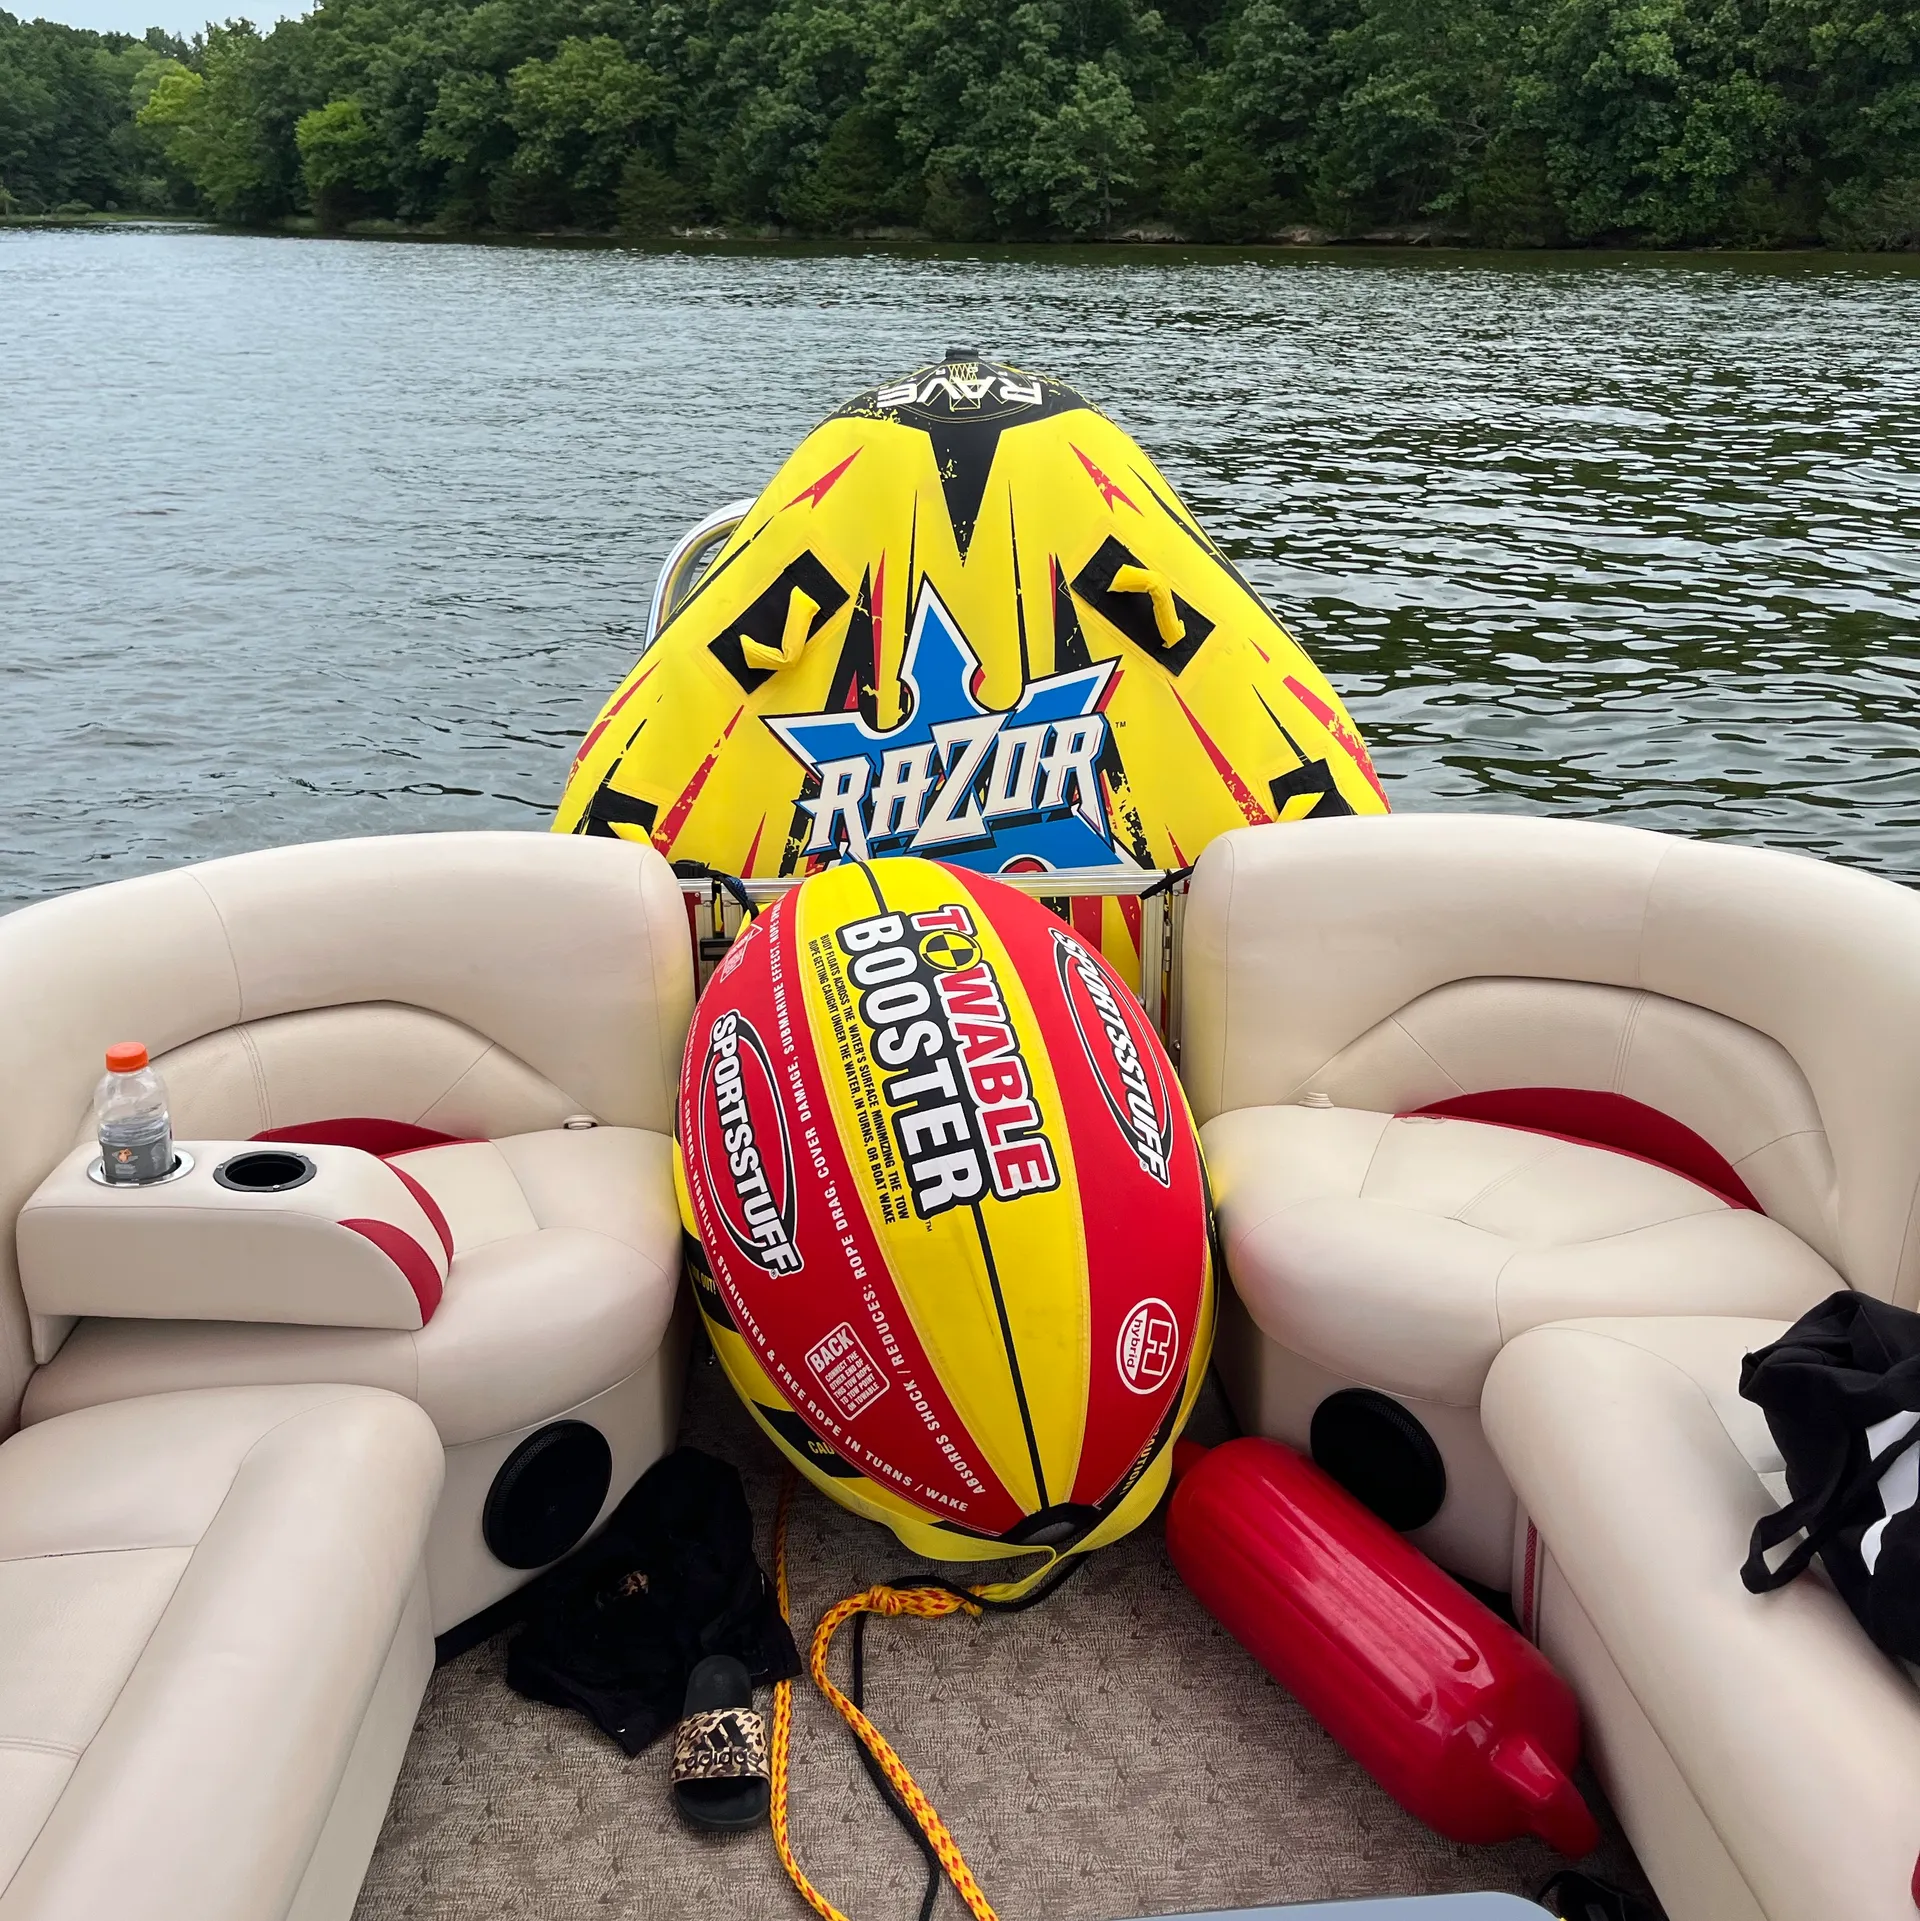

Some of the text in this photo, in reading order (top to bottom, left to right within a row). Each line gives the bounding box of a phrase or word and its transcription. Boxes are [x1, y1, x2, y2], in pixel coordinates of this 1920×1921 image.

[876, 376, 1043, 409] RAVE
[804, 713, 1105, 859] RAZOR
[769, 942, 783, 982] EFFECT,
[773, 982, 795, 1055] SUBMARINE
[820, 934, 910, 1220] BUOY FLOATS ACROSS THE WATER'S SURFACE MINIMIZING THE TOW
[842, 914, 983, 1212] BOOSTER
[912, 906, 1056, 1197] TOWABLE
[1056, 931, 1168, 1183] SPORTSSTUFF
[787, 1055, 812, 1122] DAMAGE,
[808, 939, 896, 1225] ROPE GETTING CAUGHT UNDER THE WATER, IN TURNS, OR BOAT WAKE
[712, 1014, 799, 1271] SPORTSSTUFF
[805, 1127, 829, 1179] COVER
[823, 1180, 849, 1231] DRAG,
[841, 1234, 867, 1280] ROPE
[809, 1328, 855, 1373] BACK
[863, 1283, 905, 1367] REDUCES:
[1126, 1318, 1143, 1369] hybrid
[717, 1255, 766, 1347] STRAIGHTEN
[777, 1363, 806, 1401] FREE
[807, 1400, 842, 1437] ROPE
[845, 1435, 861, 1453] IN
[865, 1450, 913, 1486] TURNS
[926, 1487, 969, 1513] WAKE
[825, 1350, 859, 1382] CONNECT THE
[829, 1358, 864, 1390] OTHER END OF
[833, 1364, 872, 1399] THIS TOW ROPE
[840, 1373, 875, 1405] TO TOW POINT
[847, 1382, 880, 1411] ON TOWABLE
[903, 1379, 941, 1431] SHOCK
[935, 1434, 986, 1495] ABSORBS
[684, 1747, 760, 1767] adidas
